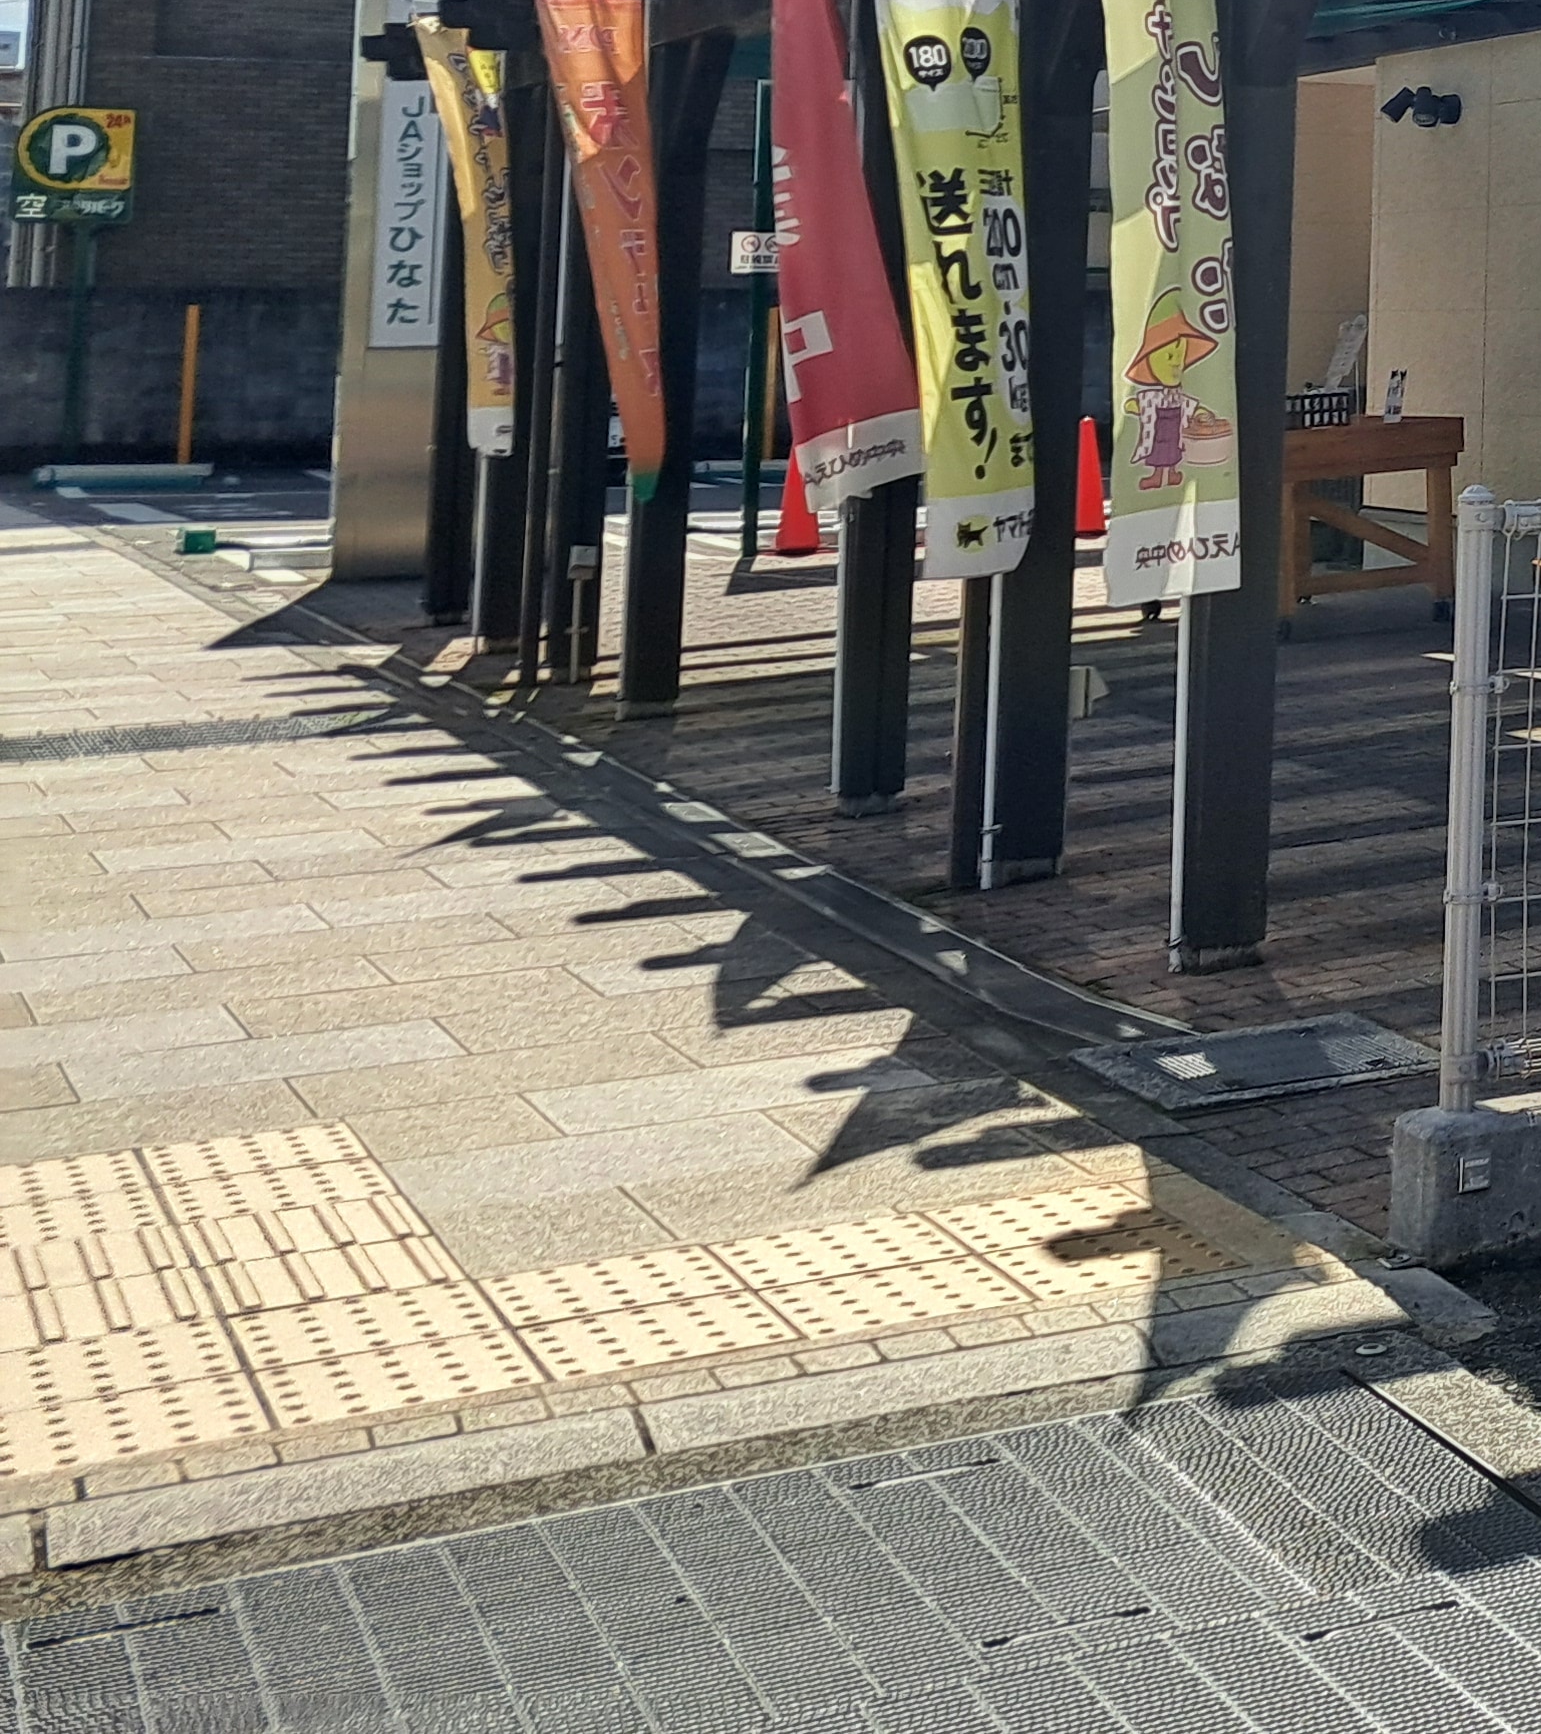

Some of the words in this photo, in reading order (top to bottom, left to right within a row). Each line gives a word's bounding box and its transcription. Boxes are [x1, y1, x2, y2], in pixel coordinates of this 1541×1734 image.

[908, 43, 947, 68] 180
[48, 123, 97, 175] P
[15, 192, 49, 219] 空
[387, 95, 426, 327] JAショップひなた
[916, 167, 999, 481] 送れます!
